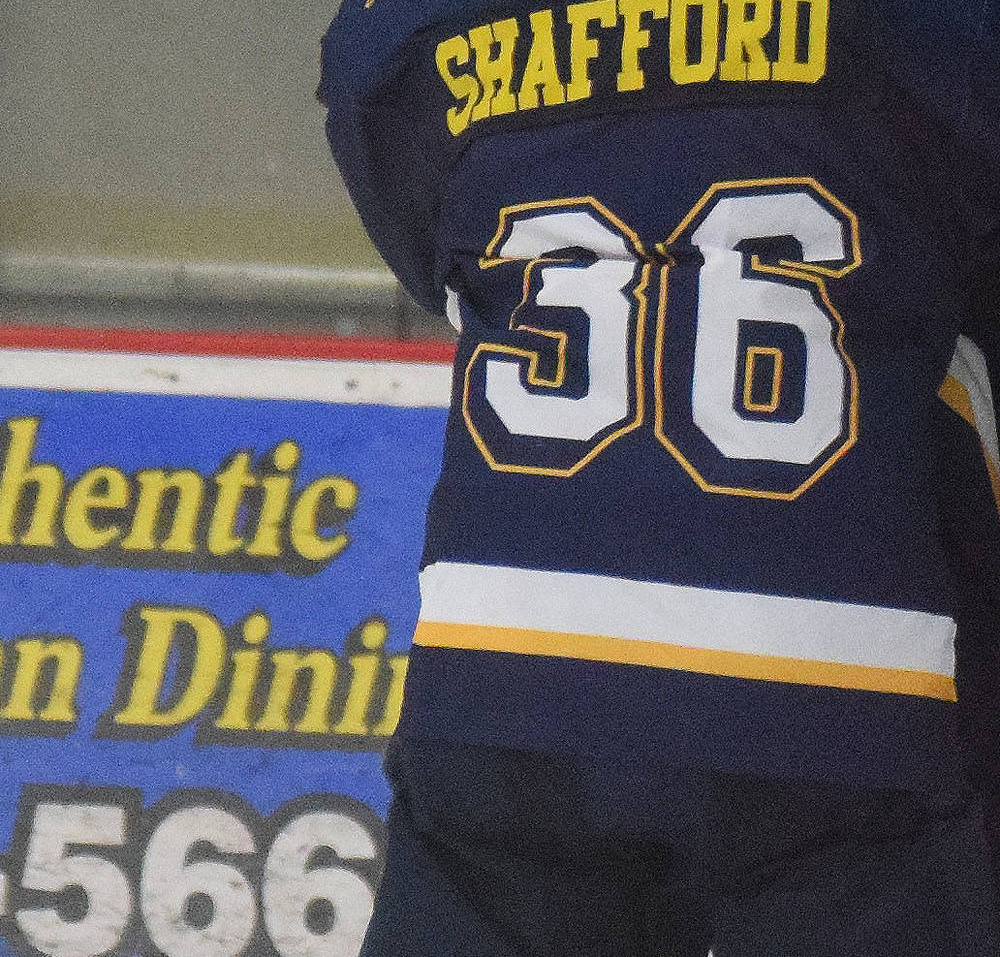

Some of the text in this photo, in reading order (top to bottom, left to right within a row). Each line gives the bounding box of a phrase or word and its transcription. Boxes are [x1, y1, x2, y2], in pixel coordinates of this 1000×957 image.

[462, 176, 863, 501] 36
[0, 415, 359, 562] hentic
[0, 633, 84, 724] n
[0, 802, 379, 957] 566
